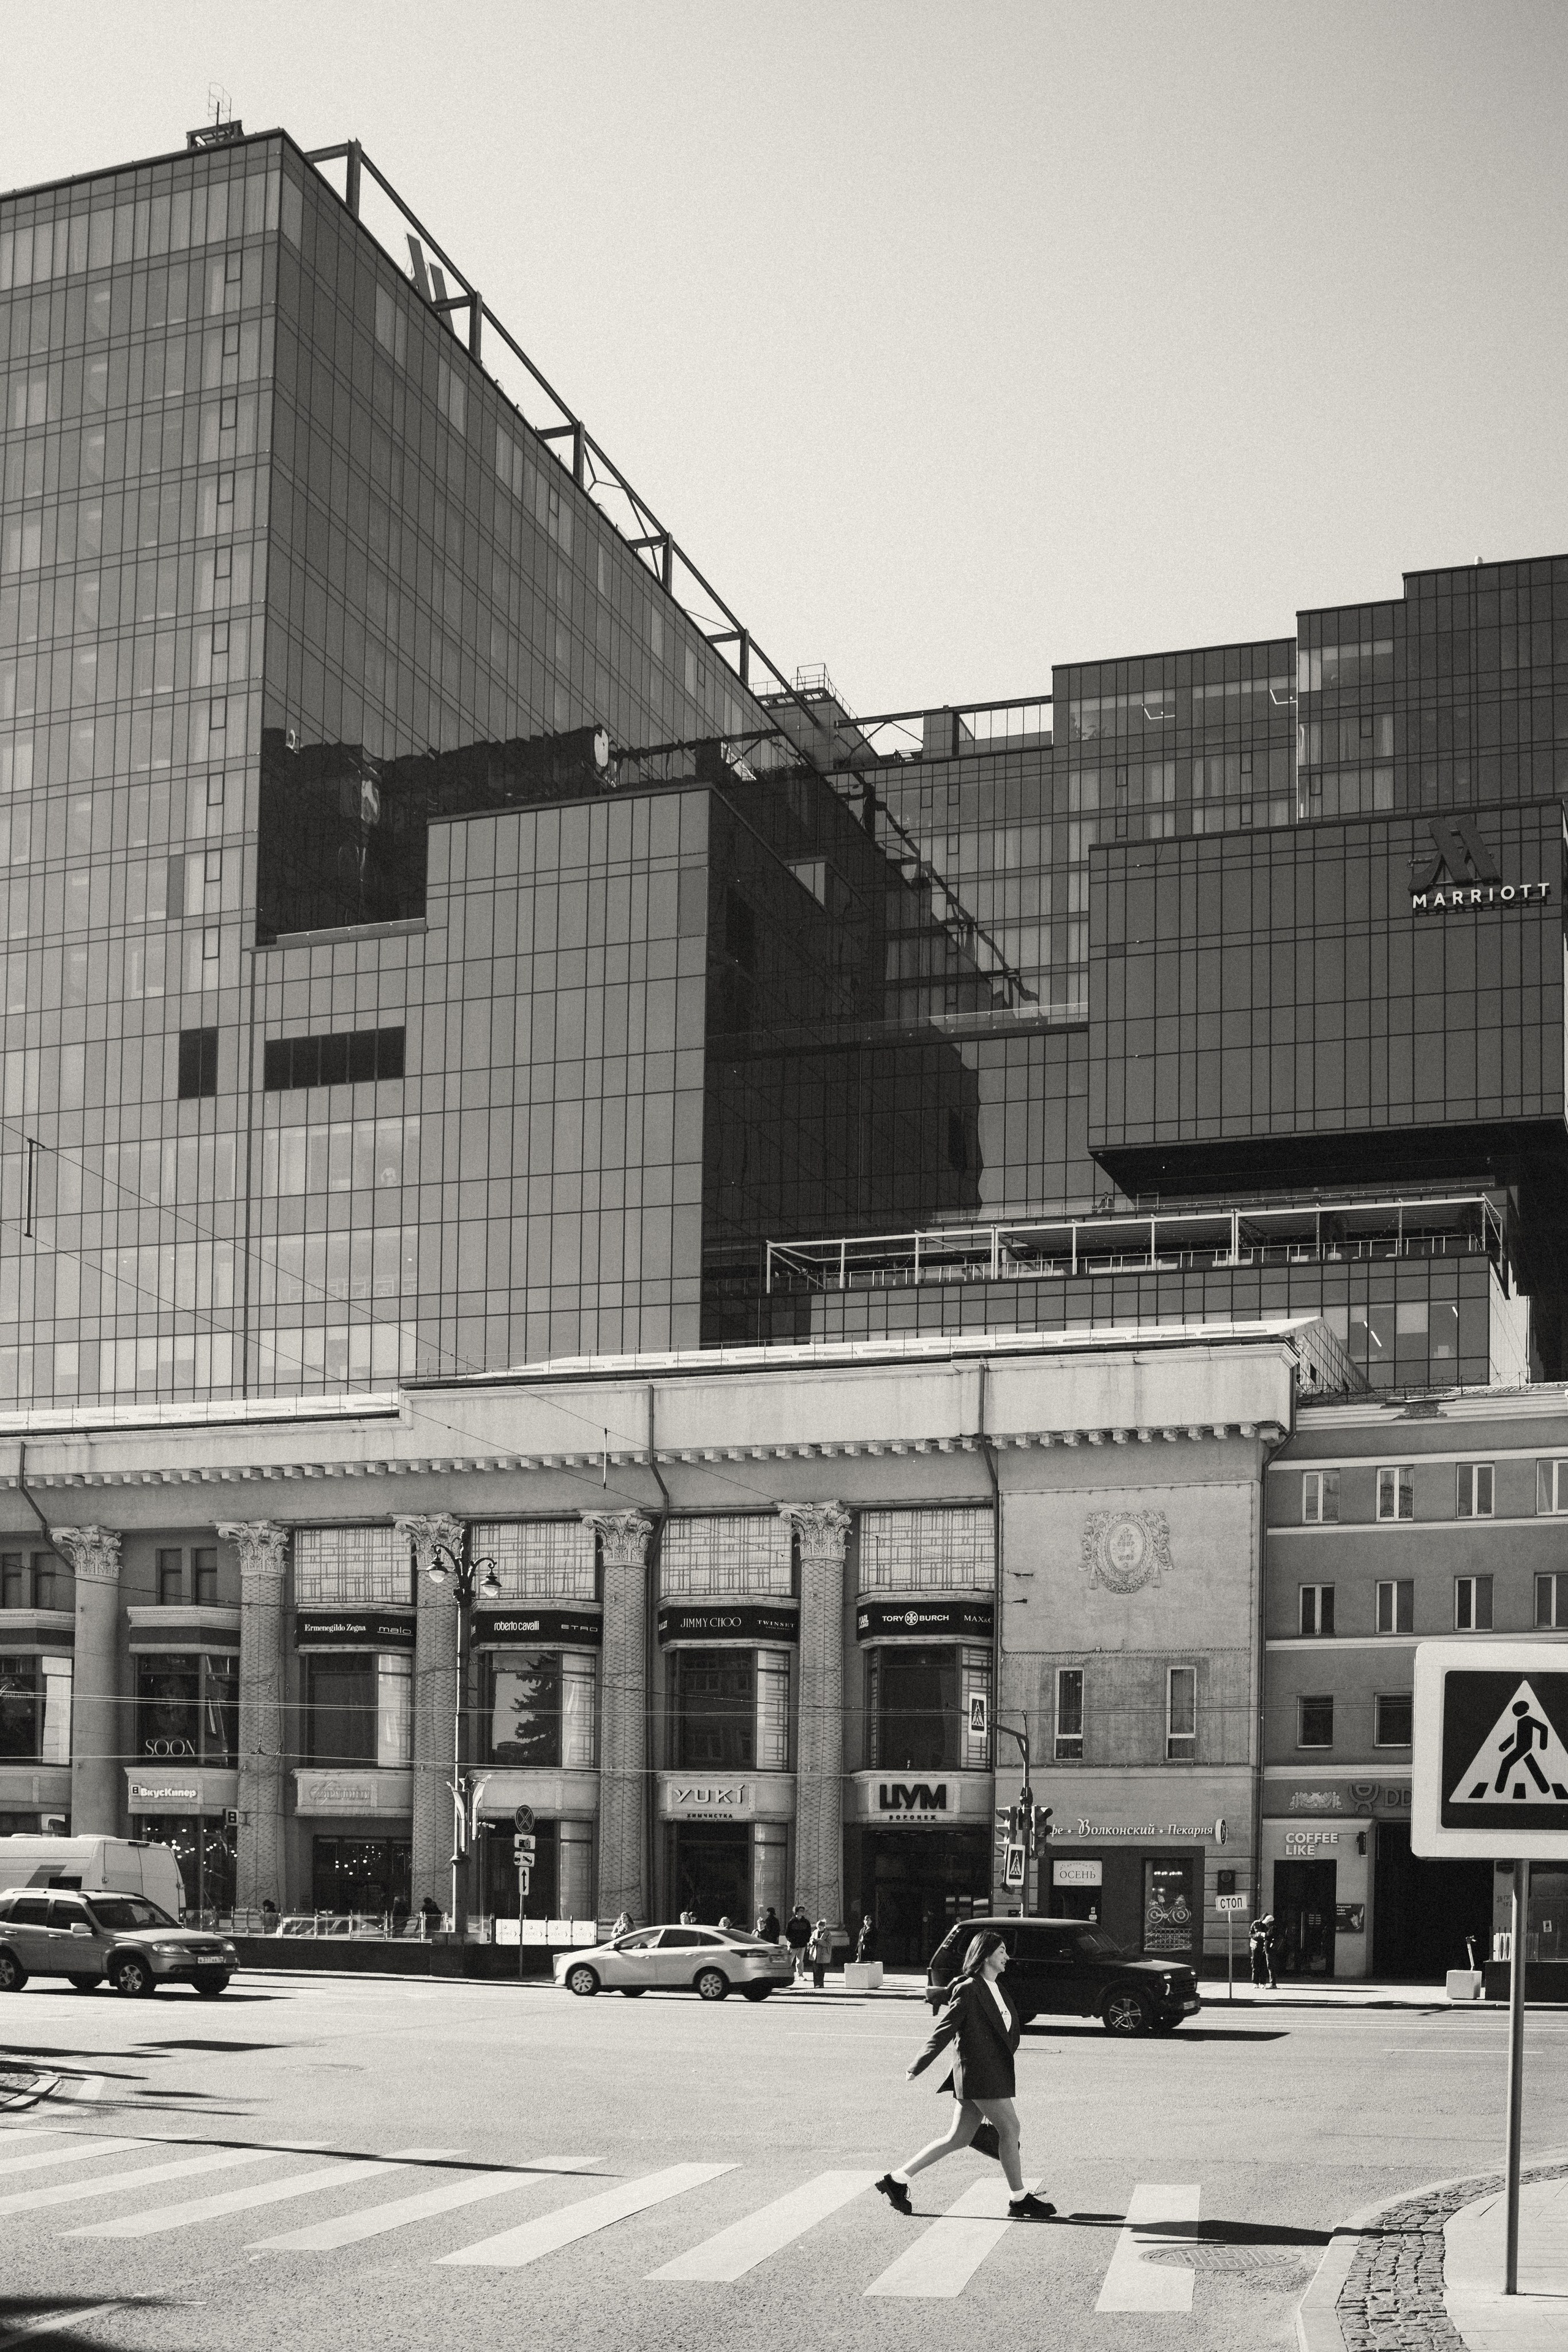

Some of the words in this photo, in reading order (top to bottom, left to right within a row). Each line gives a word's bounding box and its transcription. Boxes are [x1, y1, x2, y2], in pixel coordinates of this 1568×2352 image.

[1412, 883, 1550, 908] MARRIOTT
[680, 1618, 708, 1628] JIMMY
[710, 1617, 742, 1627] CHOO
[757, 1619, 795, 1628] TWINSET
[964, 1615, 993, 1623] MAX&C
[304, 1624, 345, 1633] Ermenegildo
[346, 1624, 366, 1633] Zegna
[494, 1621, 518, 1631] roberto
[518, 1620, 540, 1630] cavalli
[561, 1624, 598, 1632] ETRO
[145, 1739, 196, 1756] SOON
[880, 1784, 947, 1809] ЦУМ
[1384, 1788, 1412, 1807] DD
[1050, 1824, 1063, 1838] фе
[1077, 1819, 1155, 1838] Волконский
[1167, 1824, 1213, 1838] Пекарня
[1286, 1833, 1338, 1844] COFFEE
[1286, 1845, 1315, 1855] LIKE
[1060, 1870, 1096, 1879] ОСЕНЬ
[1220, 1897, 1243, 1909] СТОП
